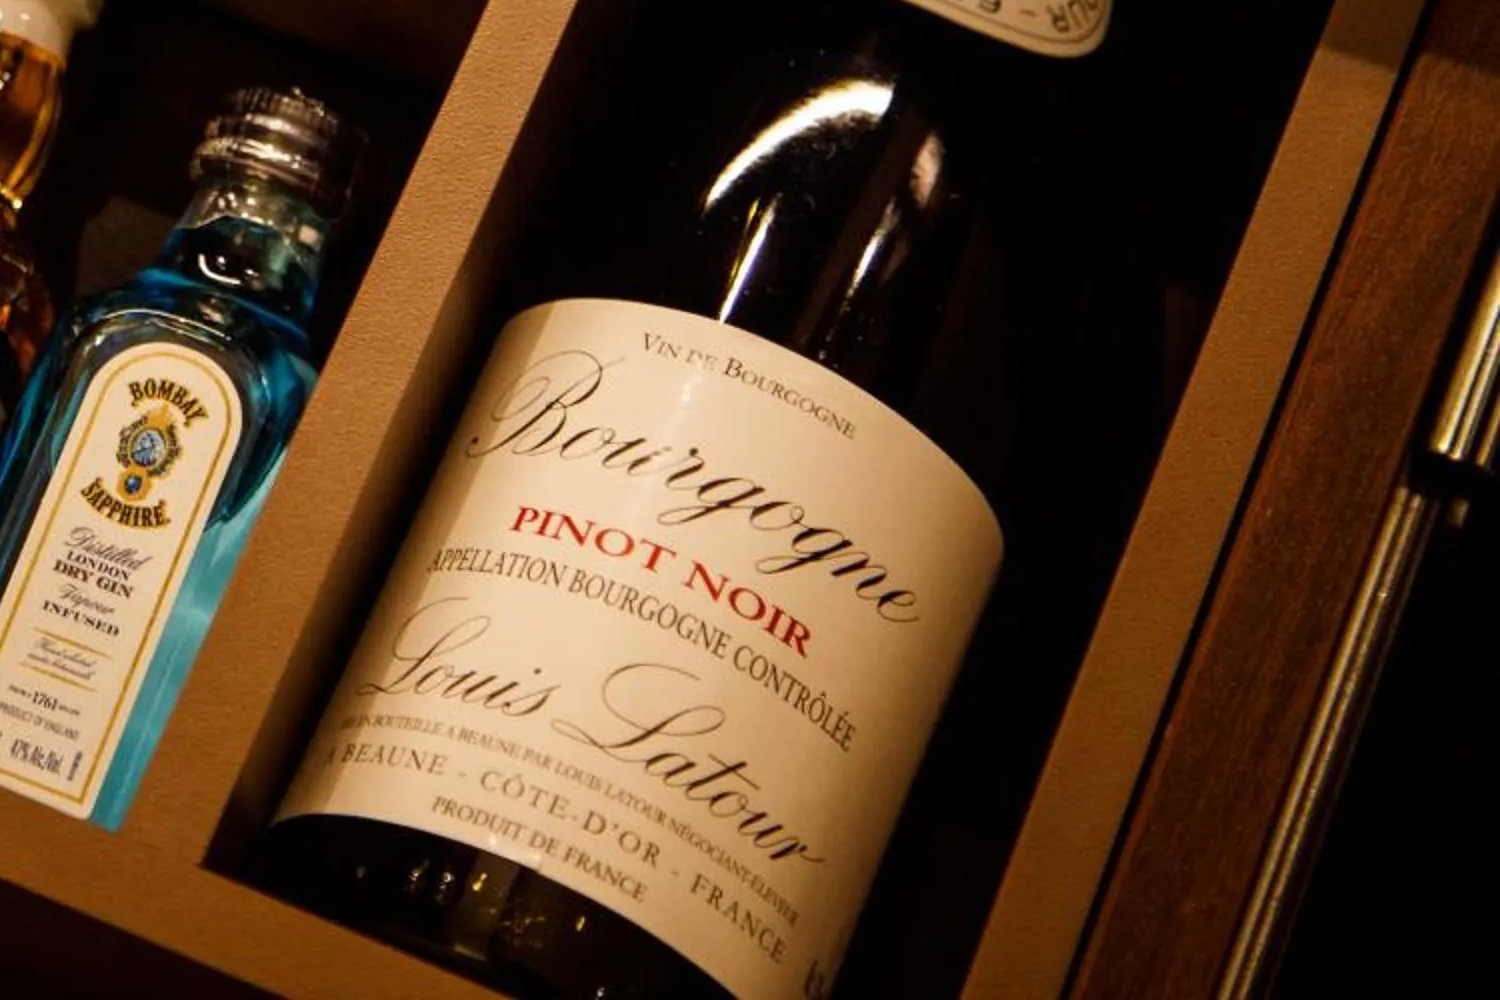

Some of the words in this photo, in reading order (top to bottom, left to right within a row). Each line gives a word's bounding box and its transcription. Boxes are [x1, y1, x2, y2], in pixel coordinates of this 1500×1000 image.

[128, 378, 209, 427] BOMBAY
[723, 356, 857, 440] BOURGOGNE
[80, 476, 167, 528] SAPPHIRE
[466, 349, 920, 623] Bourgogne
[52, 559, 94, 584] DRY
[96, 575, 134, 599] GIN
[63, 525, 153, 571] Distilled
[67, 550, 133, 582] LONDON
[508, 504, 677, 574] PINOT
[683, 559, 813, 659] NOIR
[41, 600, 121, 638] INFUSED
[426, 546, 569, 587] APPELLATION
[567, 567, 732, 660] BOURGOGNE
[732, 643, 858, 753] CONTRÔLÉE
[357, 596, 562, 717] Louis
[549, 662, 826, 865] Latour
[520, 746, 552, 770] PAR
[553, 760, 602, 792] LOUIS
[604, 783, 667, 828] LATOUR
[341, 743, 448, 776] BEAUNE
[689, 873, 787, 965] FRANCE
[431, 795, 528, 842] PRODUIT
[528, 830, 561, 857] DE
[561, 845, 649, 904] FRANCE
